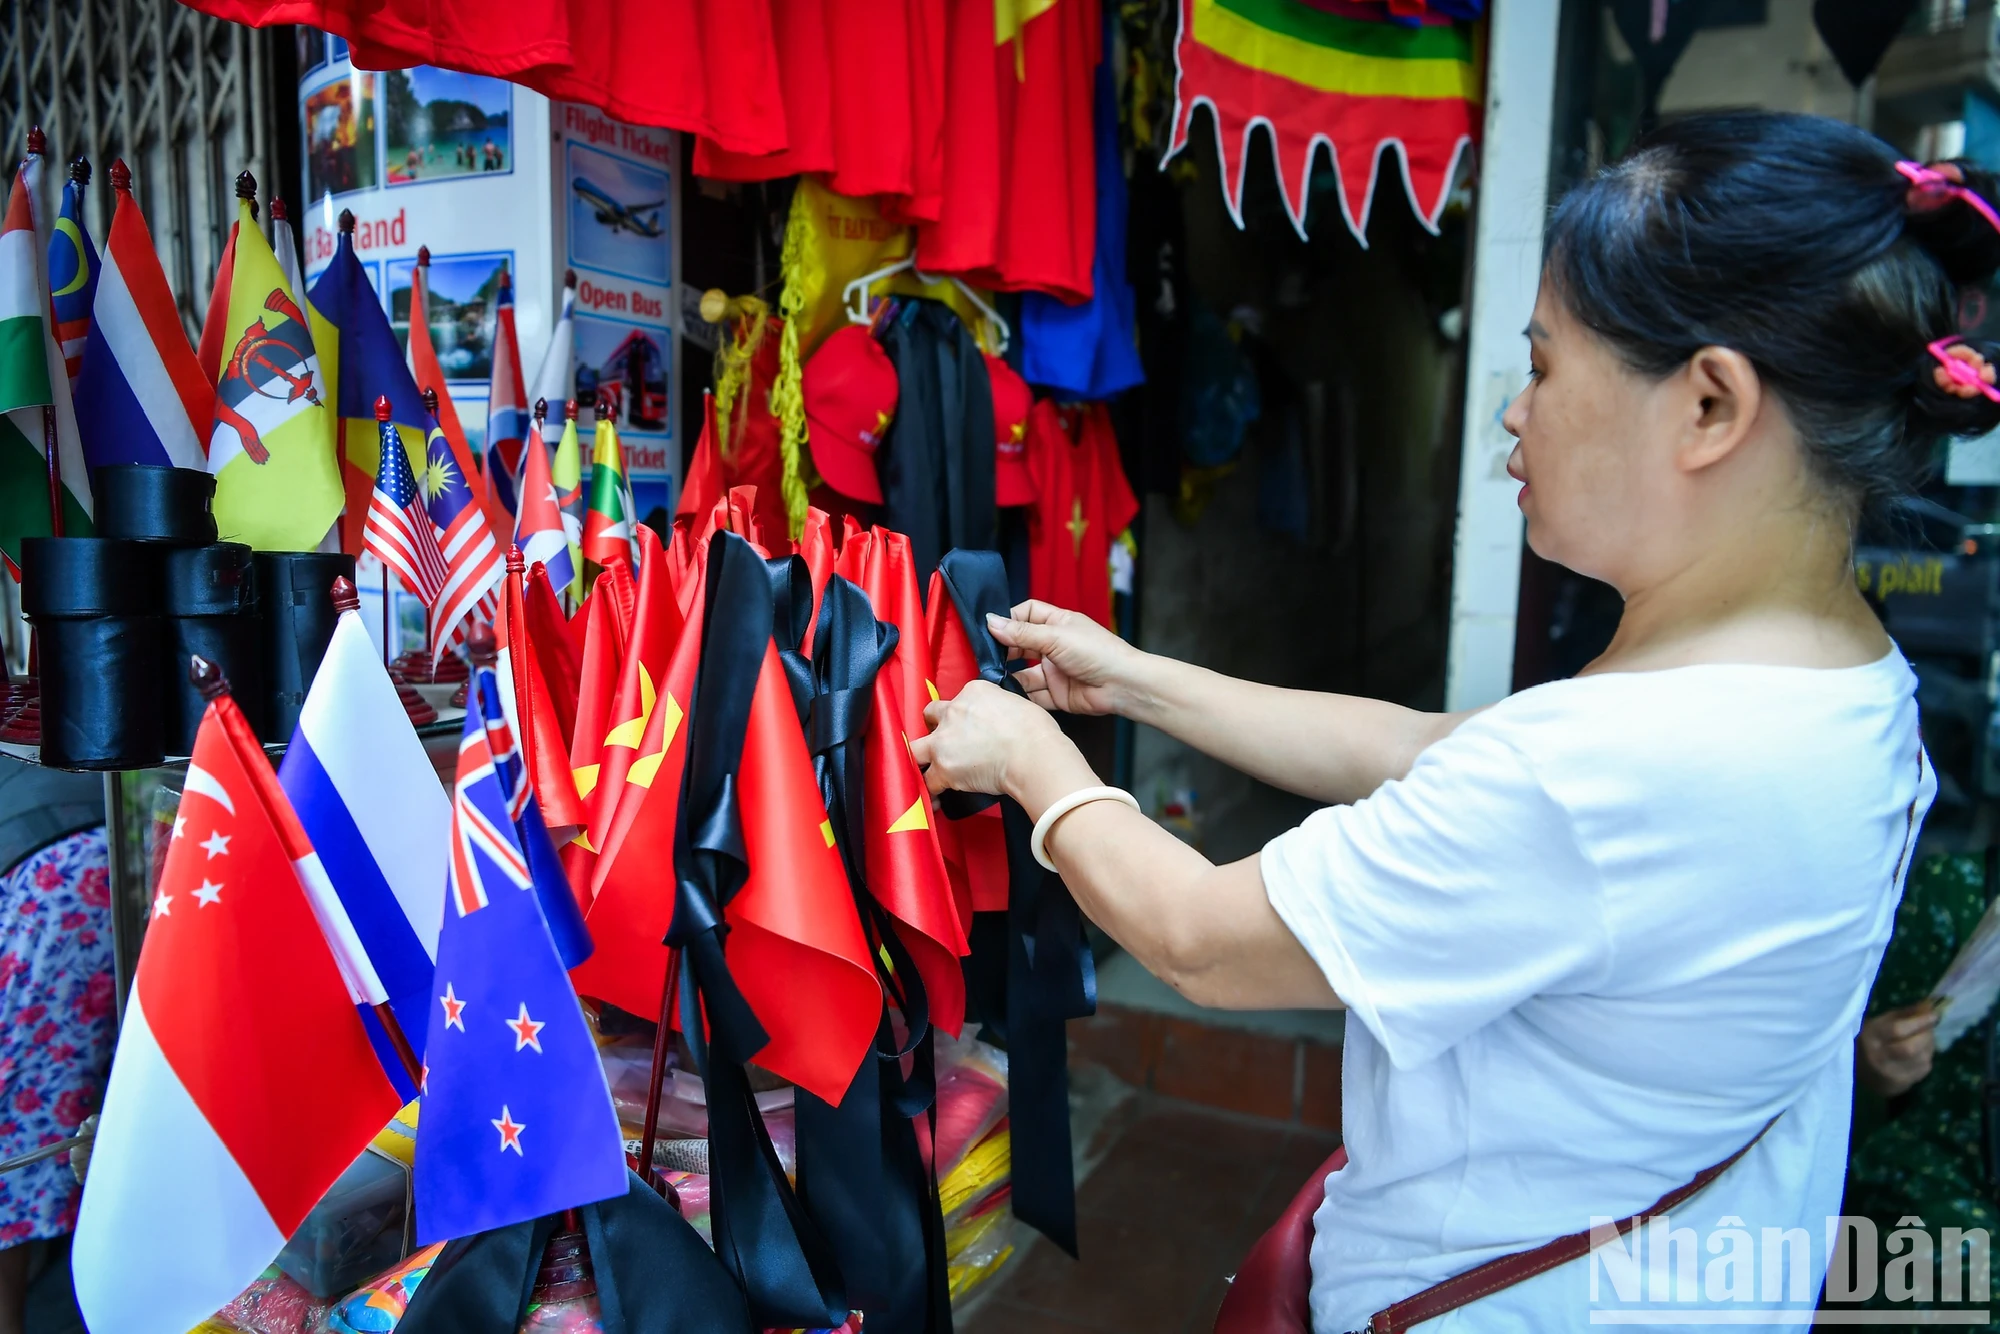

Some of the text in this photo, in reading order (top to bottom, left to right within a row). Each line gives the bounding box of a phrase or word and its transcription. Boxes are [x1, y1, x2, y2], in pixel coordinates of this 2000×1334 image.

[565, 104, 671, 167] Flight Ticket
[579, 279, 663, 318] Open Bus
[624, 442, 667, 471] Ticket
